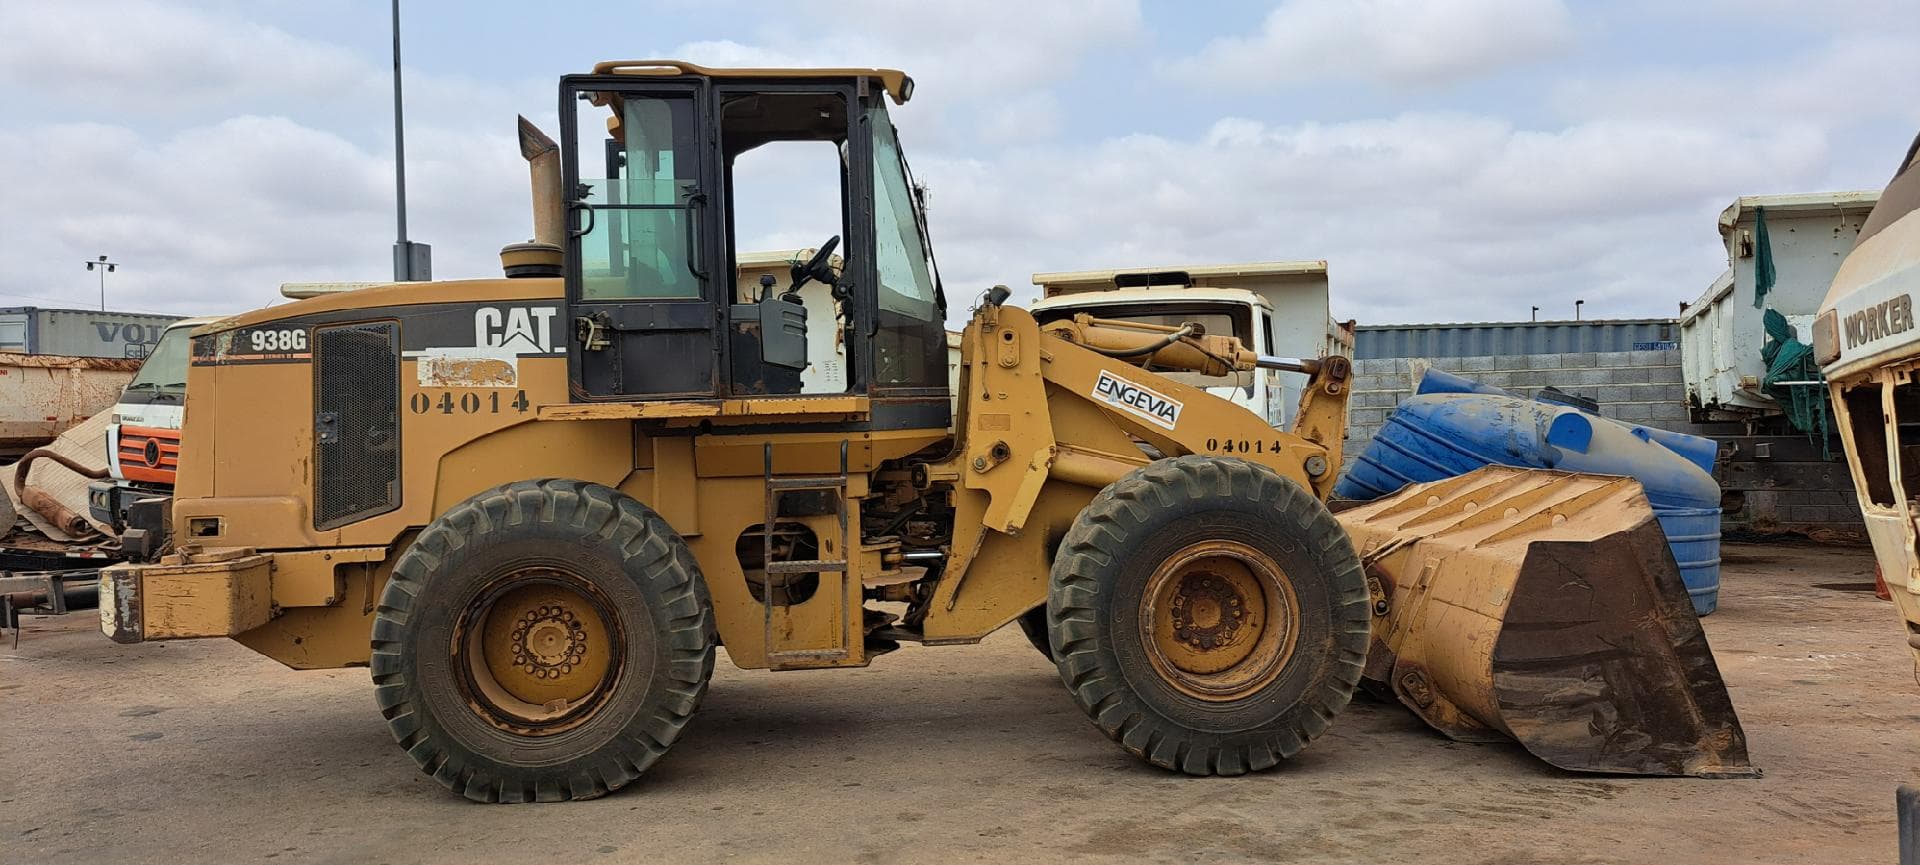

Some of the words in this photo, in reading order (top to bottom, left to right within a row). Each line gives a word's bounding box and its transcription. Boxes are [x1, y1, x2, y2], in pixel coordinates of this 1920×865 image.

[475, 307, 557, 352] CAT
[1843, 293, 1914, 350] WORKER
[251, 328, 306, 351] 938G
[410, 390, 530, 415] 04014
[1097, 374, 1176, 422] ENGEVIA
[1206, 437, 1282, 454] 04014
